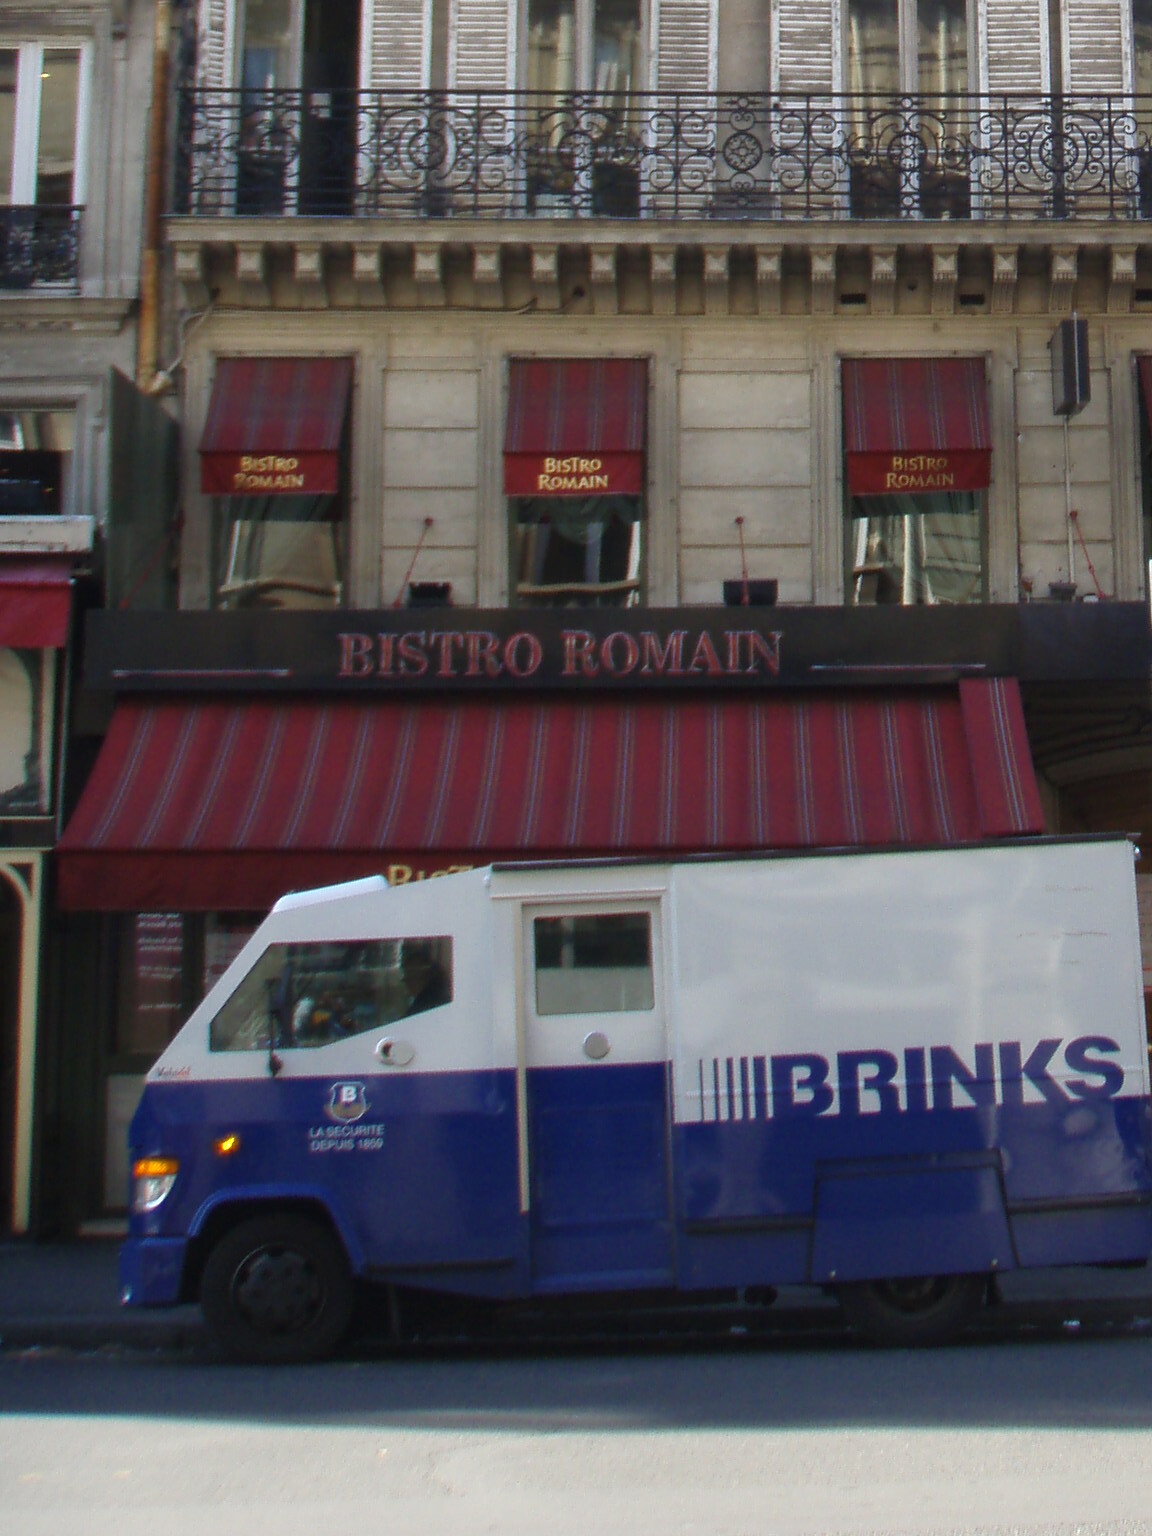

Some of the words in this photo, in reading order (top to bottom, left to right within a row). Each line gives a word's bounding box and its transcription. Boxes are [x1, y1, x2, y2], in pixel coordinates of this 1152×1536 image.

[544, 457, 602, 473] BISTRO
[892, 456, 948, 471] BISTRO
[538, 474, 609, 490] ROMAIN
[886, 472, 954, 488] ROMAIN
[337, 631, 543, 677] BISTRO
[560, 629, 783, 676] ROMAIN
[767, 1035, 1124, 1119] BRINKS
[342, 1086, 357, 1102] B
[310, 1127, 324, 1138] LA
[326, 1124, 384, 1137] SECURITE
[311, 1139, 355, 1151] DEPUIS
